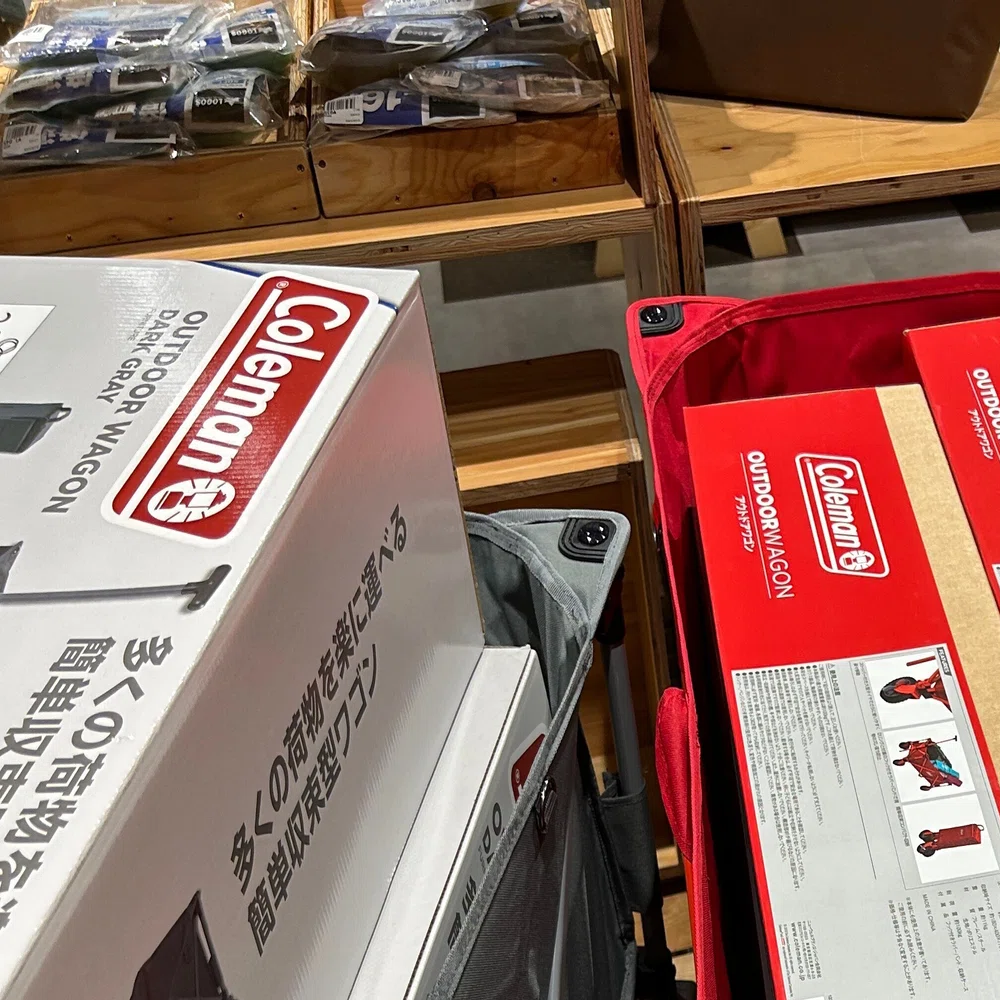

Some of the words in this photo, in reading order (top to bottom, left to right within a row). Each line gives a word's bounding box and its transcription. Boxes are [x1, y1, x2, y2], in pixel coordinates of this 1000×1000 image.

[114, 310, 208, 415] OUTDOOR
[131, 309, 180, 354] DARK
[96, 357, 142, 405] GRAY
[173, 295, 351, 474] Coleman
[41, 420, 134, 514] WAGON
[967, 408, 994, 460] アウトドアワゴン
[734, 495, 754, 552] アウトドアワゴン
[813, 462, 862, 549] Coleman
[229, 503, 408, 895] 多くの荷物を楽に運べる
[0, 635, 174, 928] 多くの荷物を
[247, 643, 377, 957] 簡単収束型ワゴン
[788, 921, 807, 982] www.coleman.co.jp
